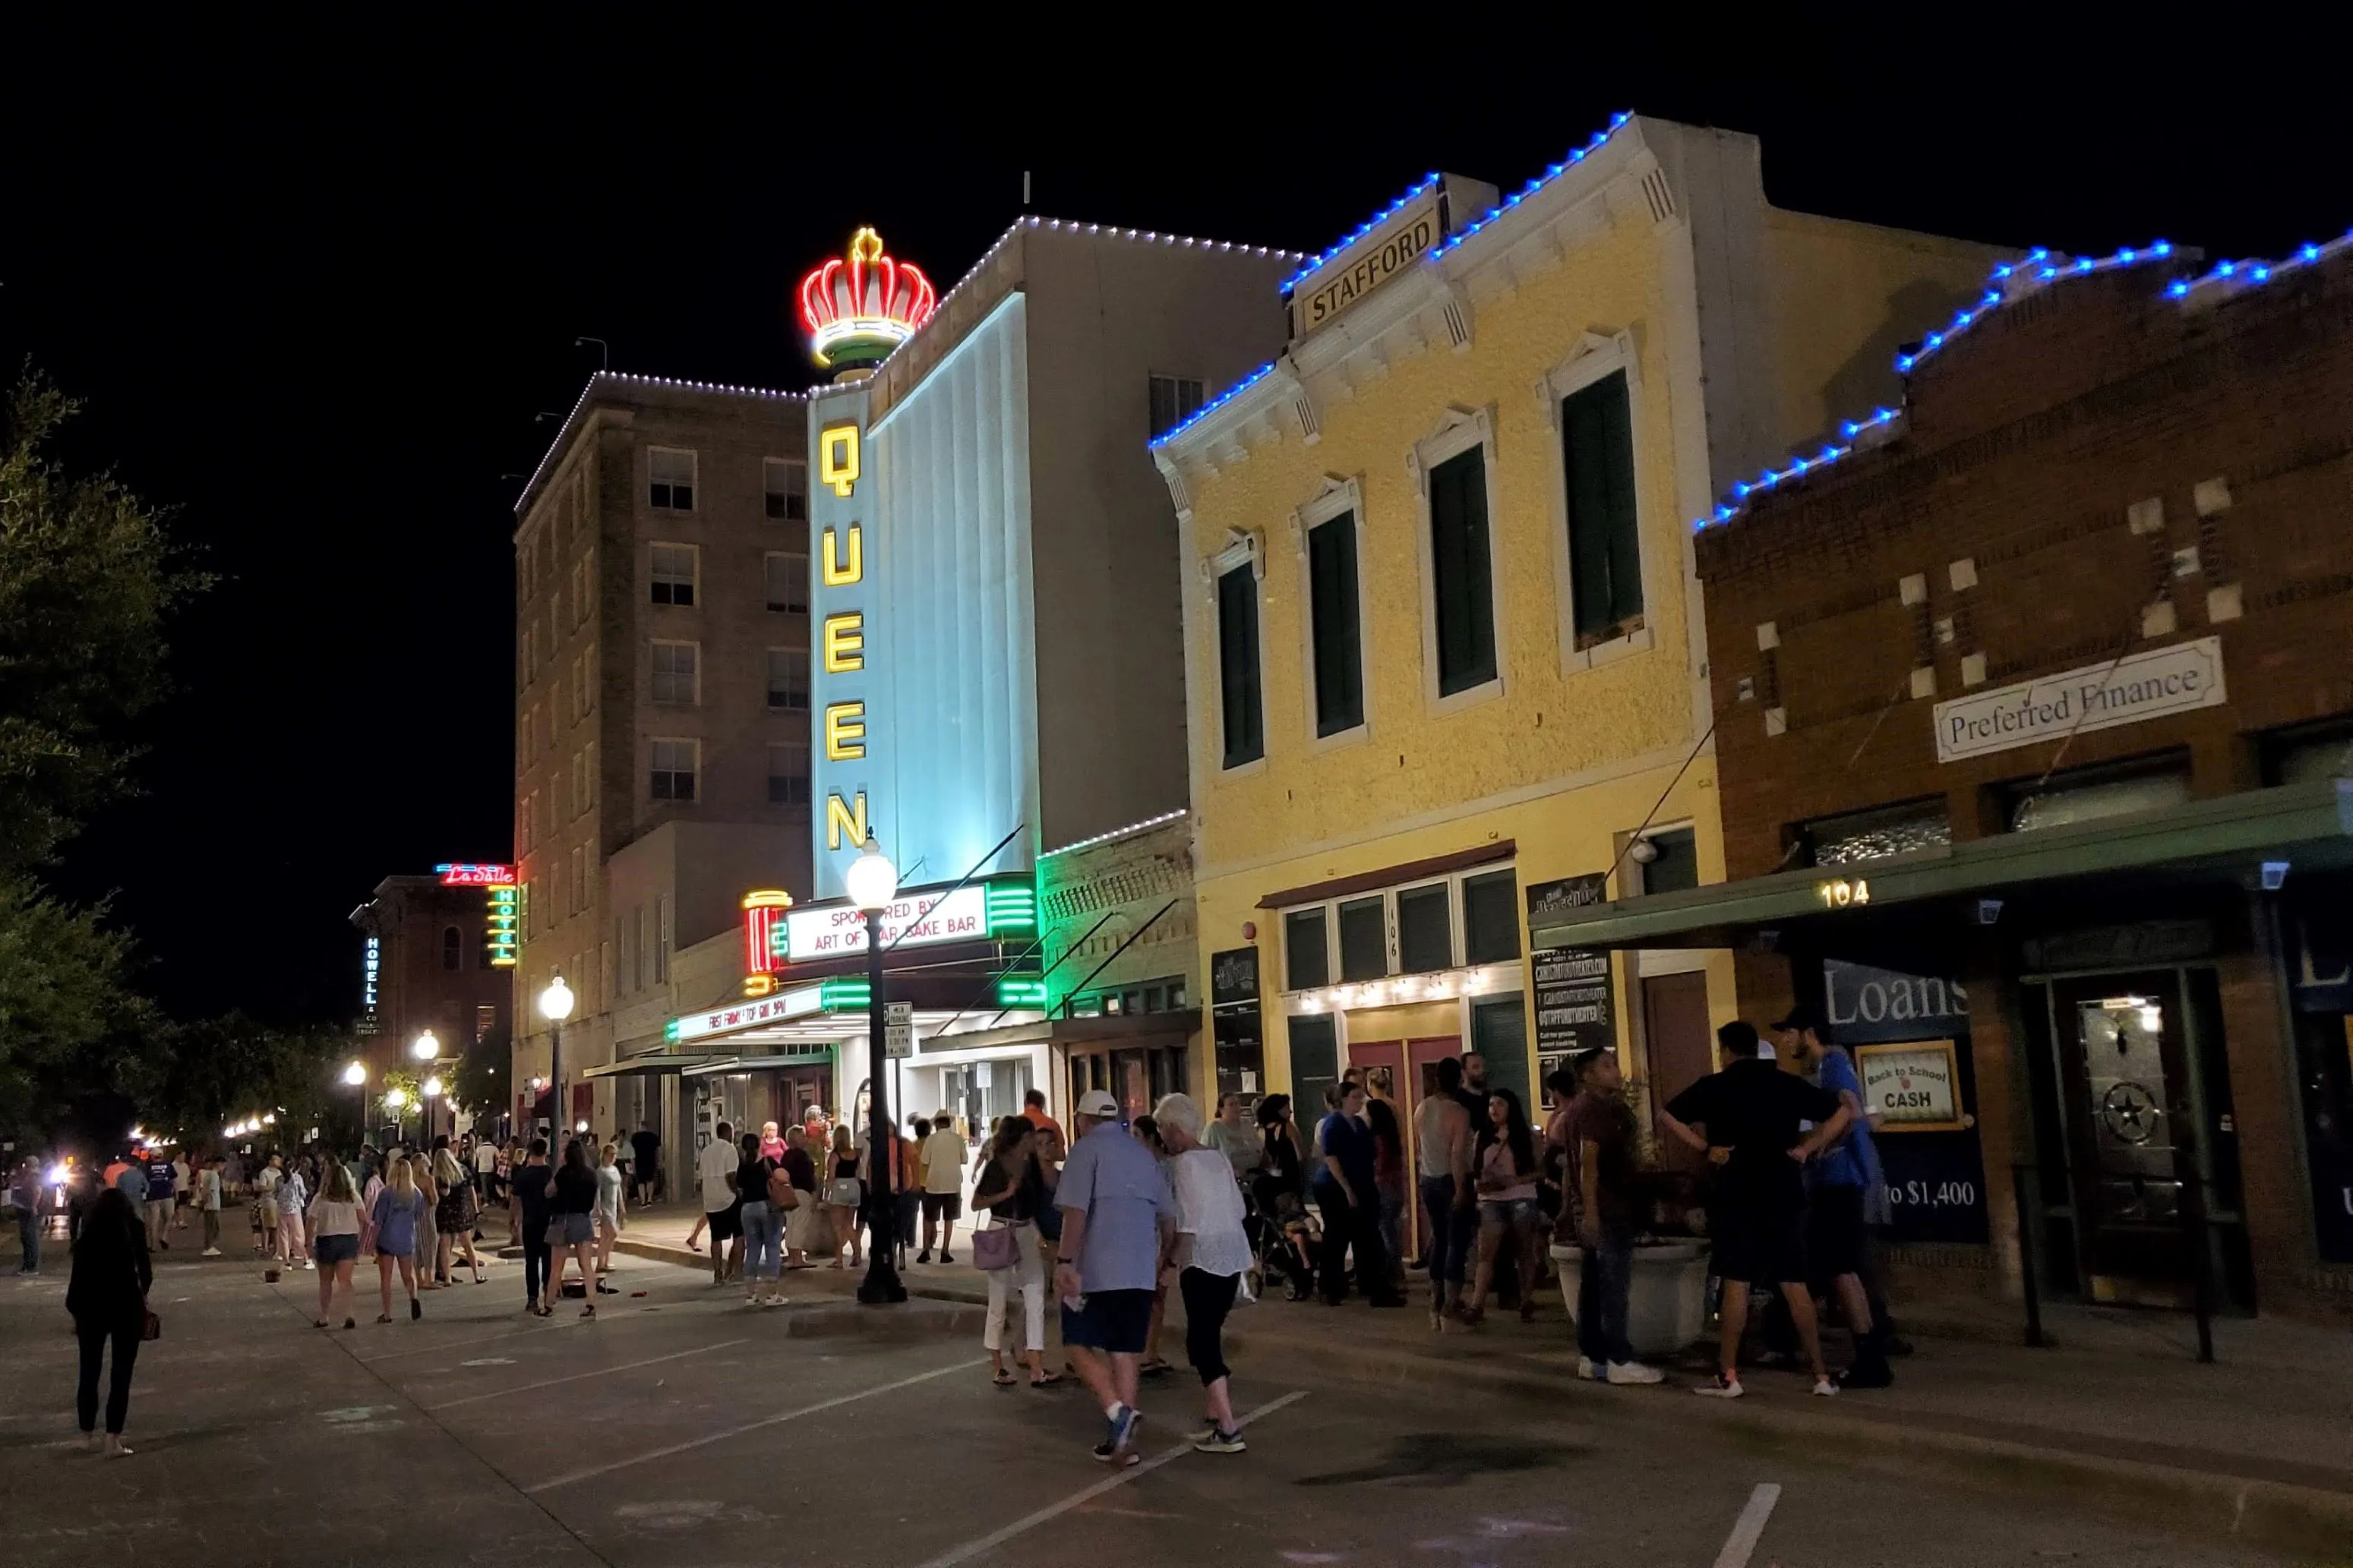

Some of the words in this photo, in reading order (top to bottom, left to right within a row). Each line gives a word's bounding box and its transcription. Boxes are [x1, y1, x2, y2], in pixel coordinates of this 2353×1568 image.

[1312, 222, 1430, 322] STAFFORD
[821, 425, 866, 850] QUEEN
[1950, 690, 2070, 744] Preferred
[2080, 669, 2200, 711] Finance
[446, 866, 471, 883] La
[472, 866, 514, 882] Salle
[919, 899, 936, 915] BY
[1822, 880, 1869, 908] 104
[499, 890, 513, 958] HOTEL
[815, 935, 839, 950] ART
[845, 931, 861, 946] OF
[947, 916, 976, 932] BAR
[367, 939, 378, 1004] HOWELL
[1824, 970, 1969, 1025] Loans
[1867, 1069, 1893, 1086] Back
[1894, 1067, 1906, 1076] to
[1909, 1066, 1947, 1084] School
[1884, 1091, 1931, 1109] CASH
[1906, 1180, 1975, 1209] $1,400
